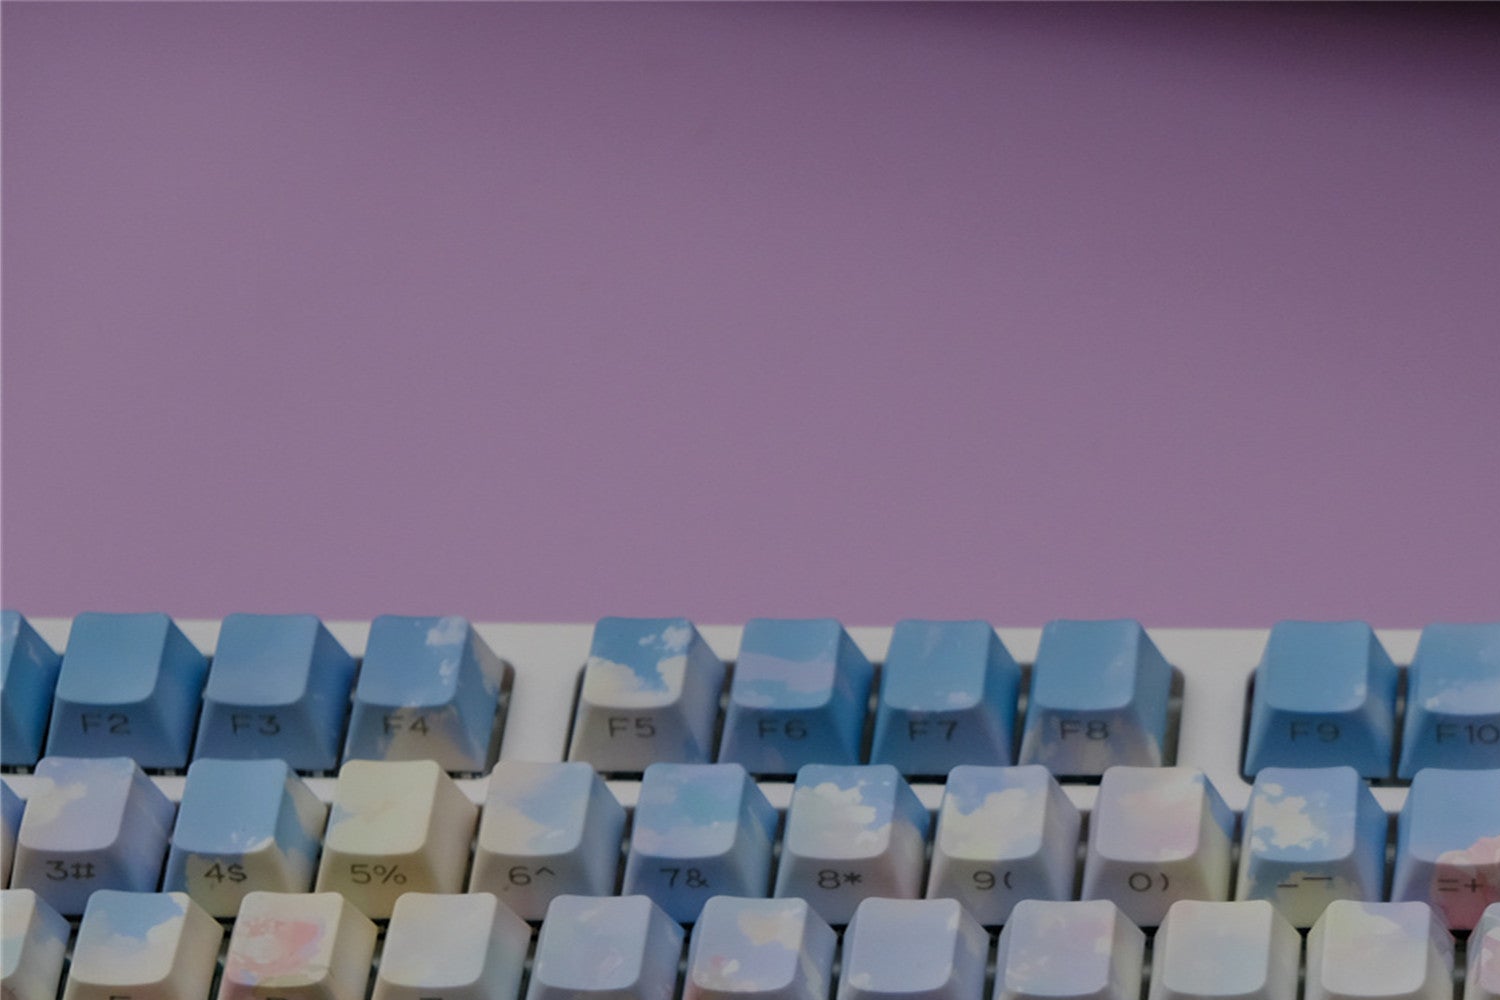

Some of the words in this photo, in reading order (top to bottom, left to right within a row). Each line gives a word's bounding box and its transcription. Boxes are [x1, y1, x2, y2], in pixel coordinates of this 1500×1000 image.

[81, 713, 130, 735] F2
[232, 714, 281, 736] F3
[383, 715, 430, 736] F4
[607, 717, 657, 738] F5
[757, 719, 808, 740] F6
[909, 720, 959, 742] F7
[1060, 720, 1110, 741] F8
[1290, 722, 1340, 743] F9
[1436, 724, 1500, 745] F10
[45, 860, 96, 881] 3#
[204, 862, 248, 884] 4$
[351, 864, 407, 886] 5%
[509, 866, 556, 886] 6^
[659, 868, 710, 889] 7&
[972, 871, 1013, 890] 9(
[1438, 878, 1484, 893] =+
